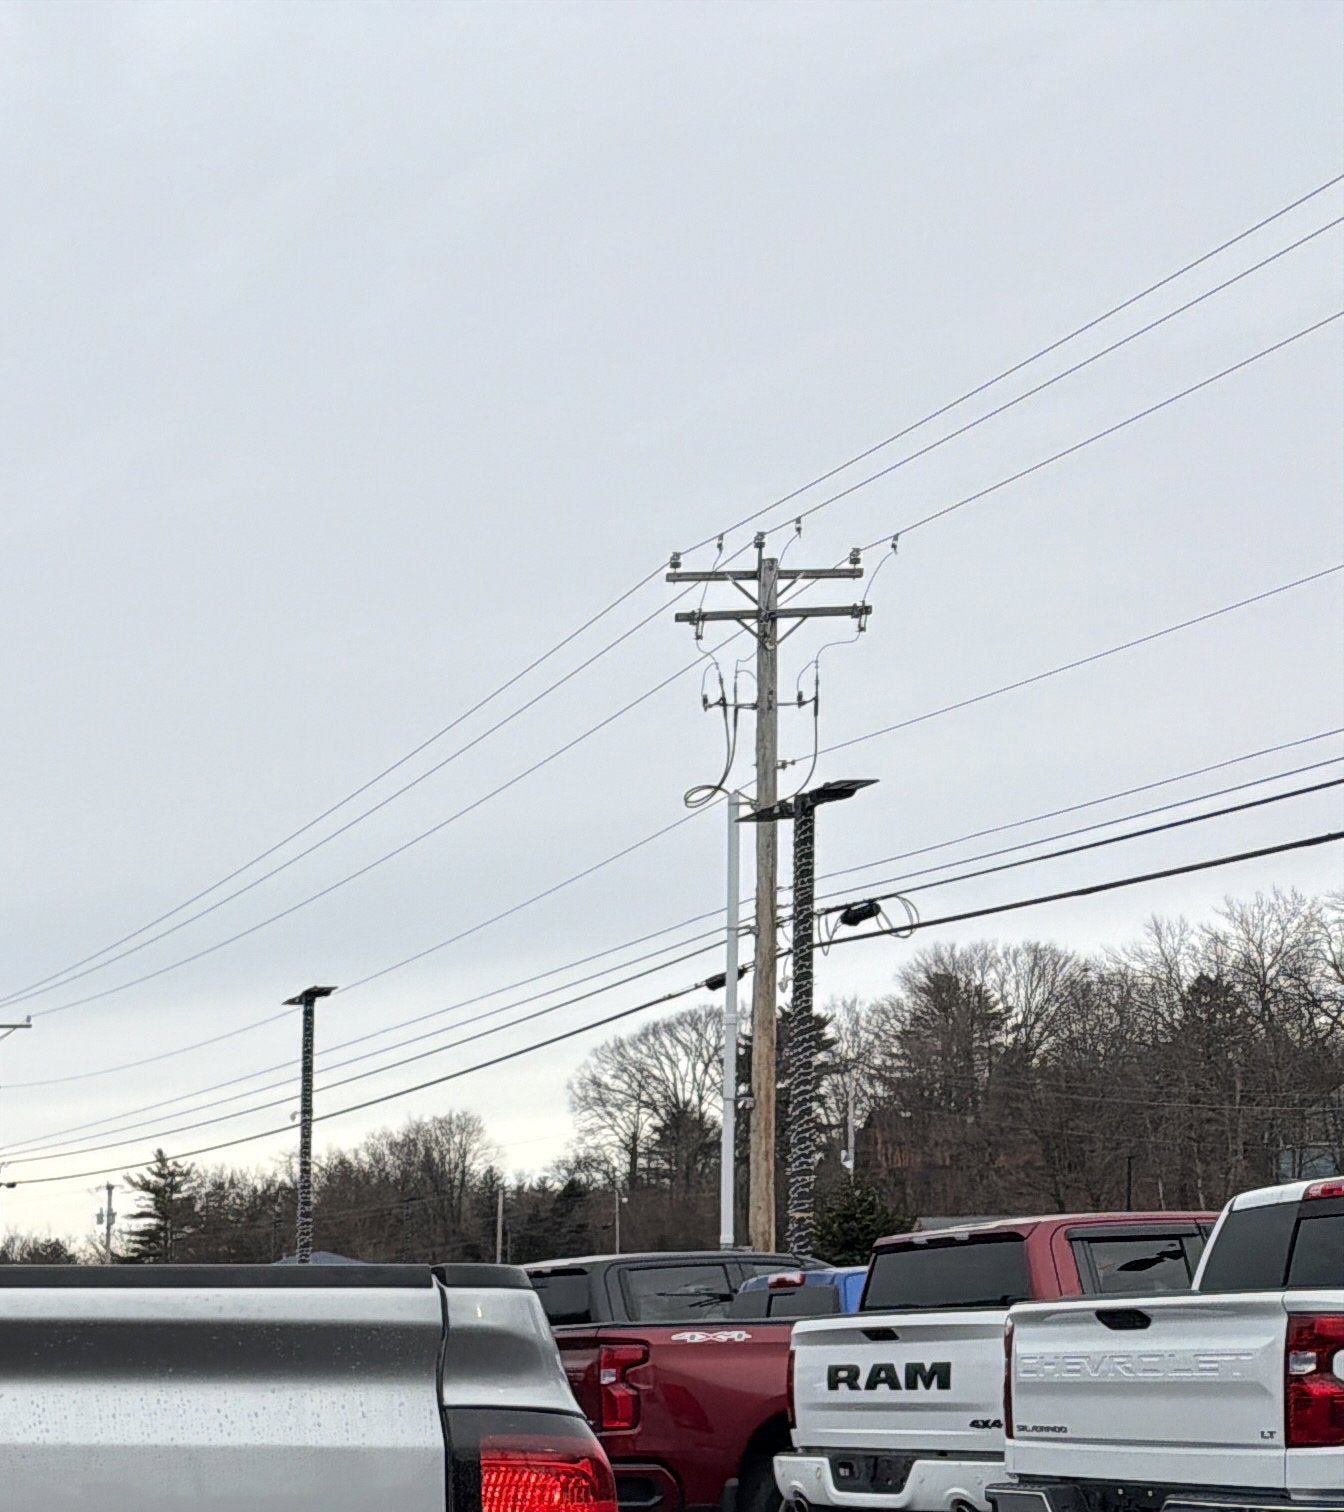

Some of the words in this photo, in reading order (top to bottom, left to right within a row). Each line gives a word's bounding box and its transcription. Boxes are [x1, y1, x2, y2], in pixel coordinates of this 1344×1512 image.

[827, 1361, 952, 1391] RAM
[1018, 1353, 1254, 1377] CHEVROLET
[1260, 1430, 1277, 1440] LT
